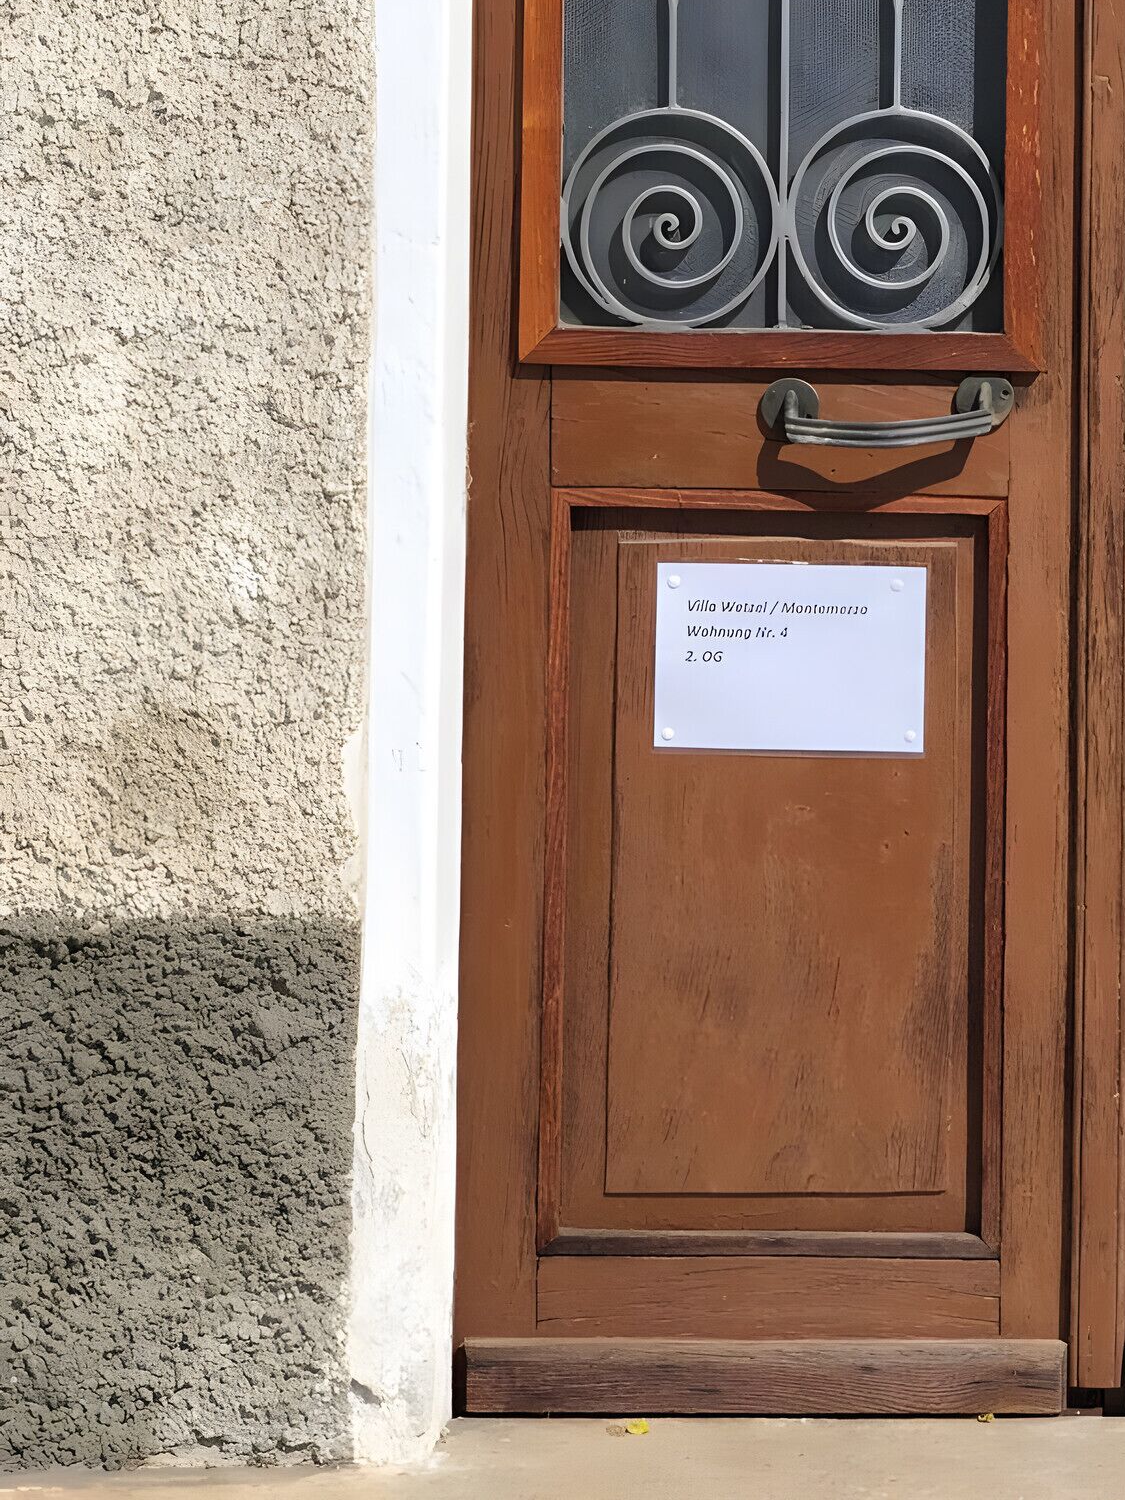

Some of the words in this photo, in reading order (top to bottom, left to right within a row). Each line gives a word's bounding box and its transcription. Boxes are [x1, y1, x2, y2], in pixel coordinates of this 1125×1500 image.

[687, 599, 717, 613] Villa
[687, 625, 752, 640] Wohnung
[755, 626, 776, 638] Nr.
[779, 627, 788, 638] 4
[684, 650, 698, 663] 2.
[702, 650, 724, 663] OG
